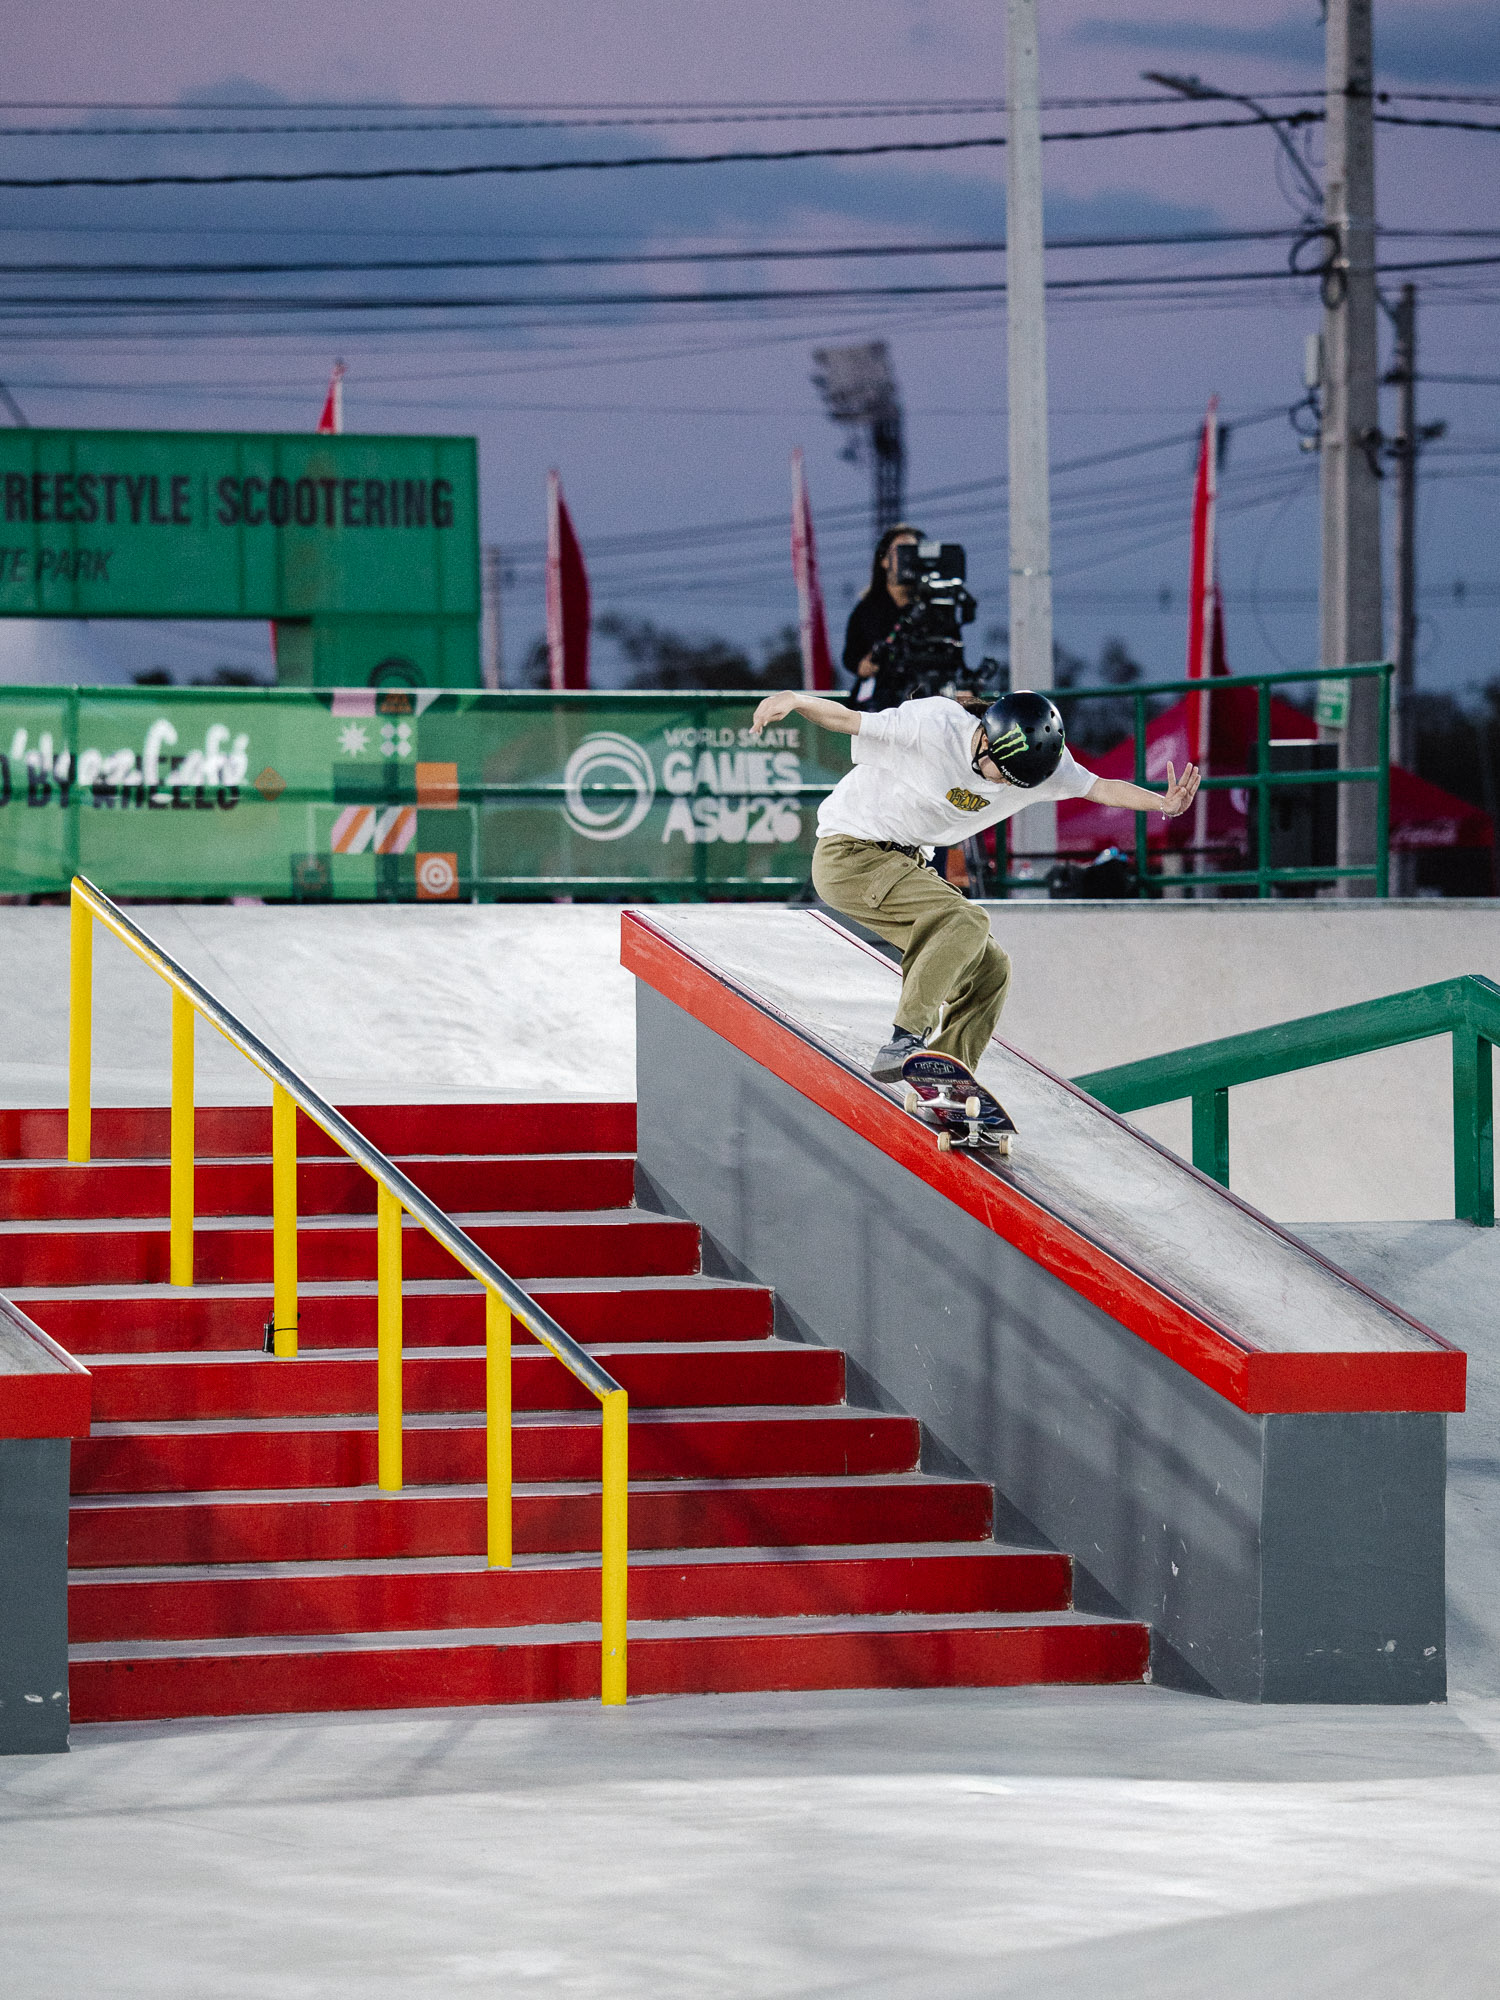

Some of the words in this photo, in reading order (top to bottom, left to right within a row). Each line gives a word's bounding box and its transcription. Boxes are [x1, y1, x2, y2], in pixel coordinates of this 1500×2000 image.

[0, 472, 190, 525] REESTYLE
[217, 475, 454, 527] SCOOTERING
[38, 548, 113, 582] PARK
[663, 727, 734, 748] WORLD
[738, 727, 799, 748] SKATE
[662, 751, 800, 795] GAMES
[661, 797, 800, 844] ASU26
